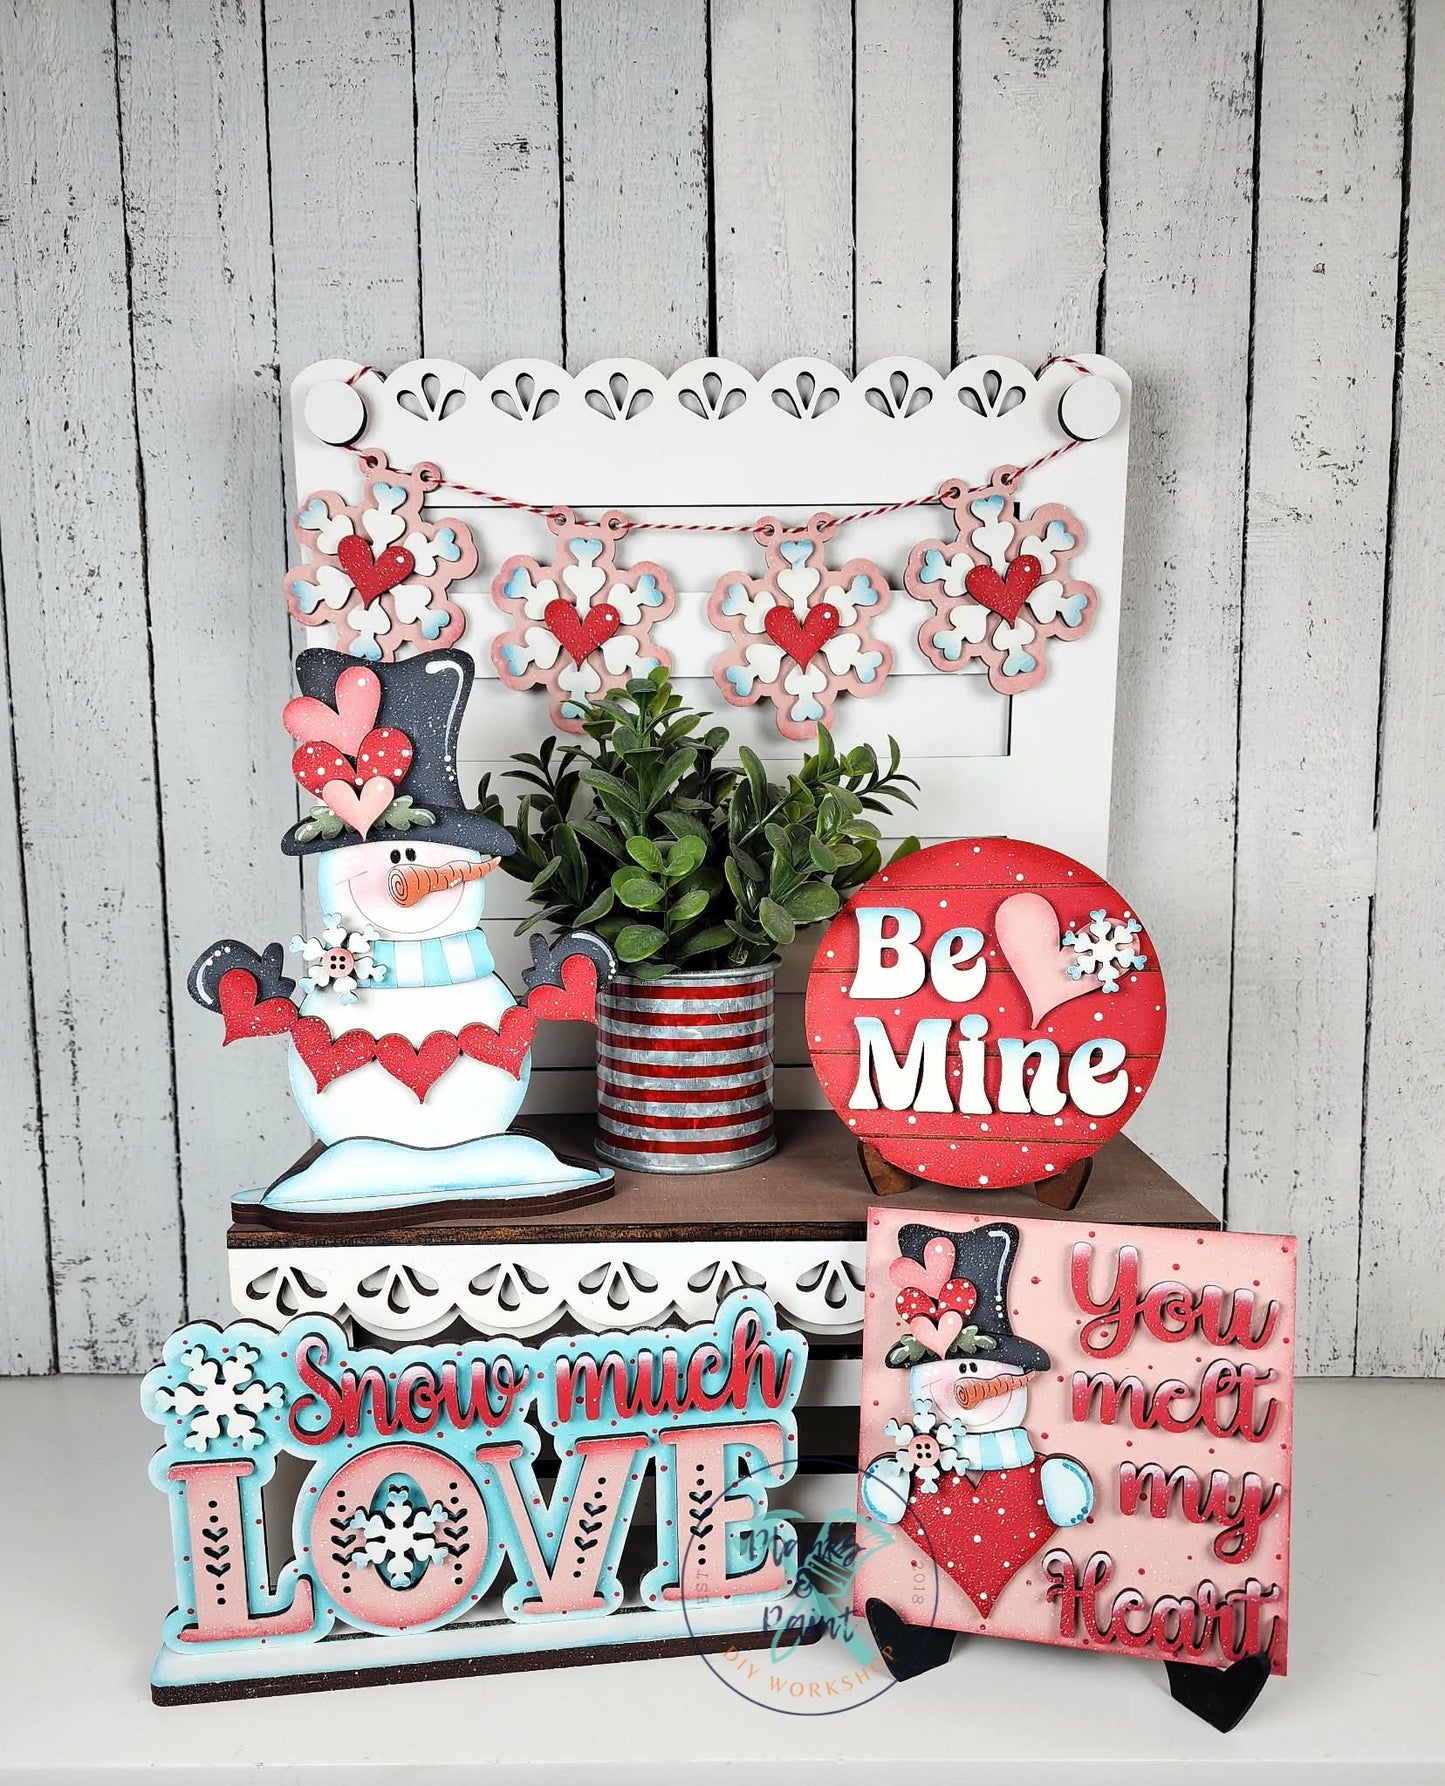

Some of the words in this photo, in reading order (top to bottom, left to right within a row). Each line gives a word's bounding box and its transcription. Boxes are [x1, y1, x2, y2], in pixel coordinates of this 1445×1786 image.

[849, 906, 988, 1003] Be
[848, 1013, 1130, 1117] Mine
[1070, 1241, 1280, 1359] You
[287, 1333, 530, 1446] Snow
[554, 1307, 794, 1424] much
[1070, 1358, 1279, 1443] melt
[167, 1421, 789, 1643] LOVE
[1118, 1460, 1283, 1565] my
[1041, 1547, 1282, 1664] Heart
